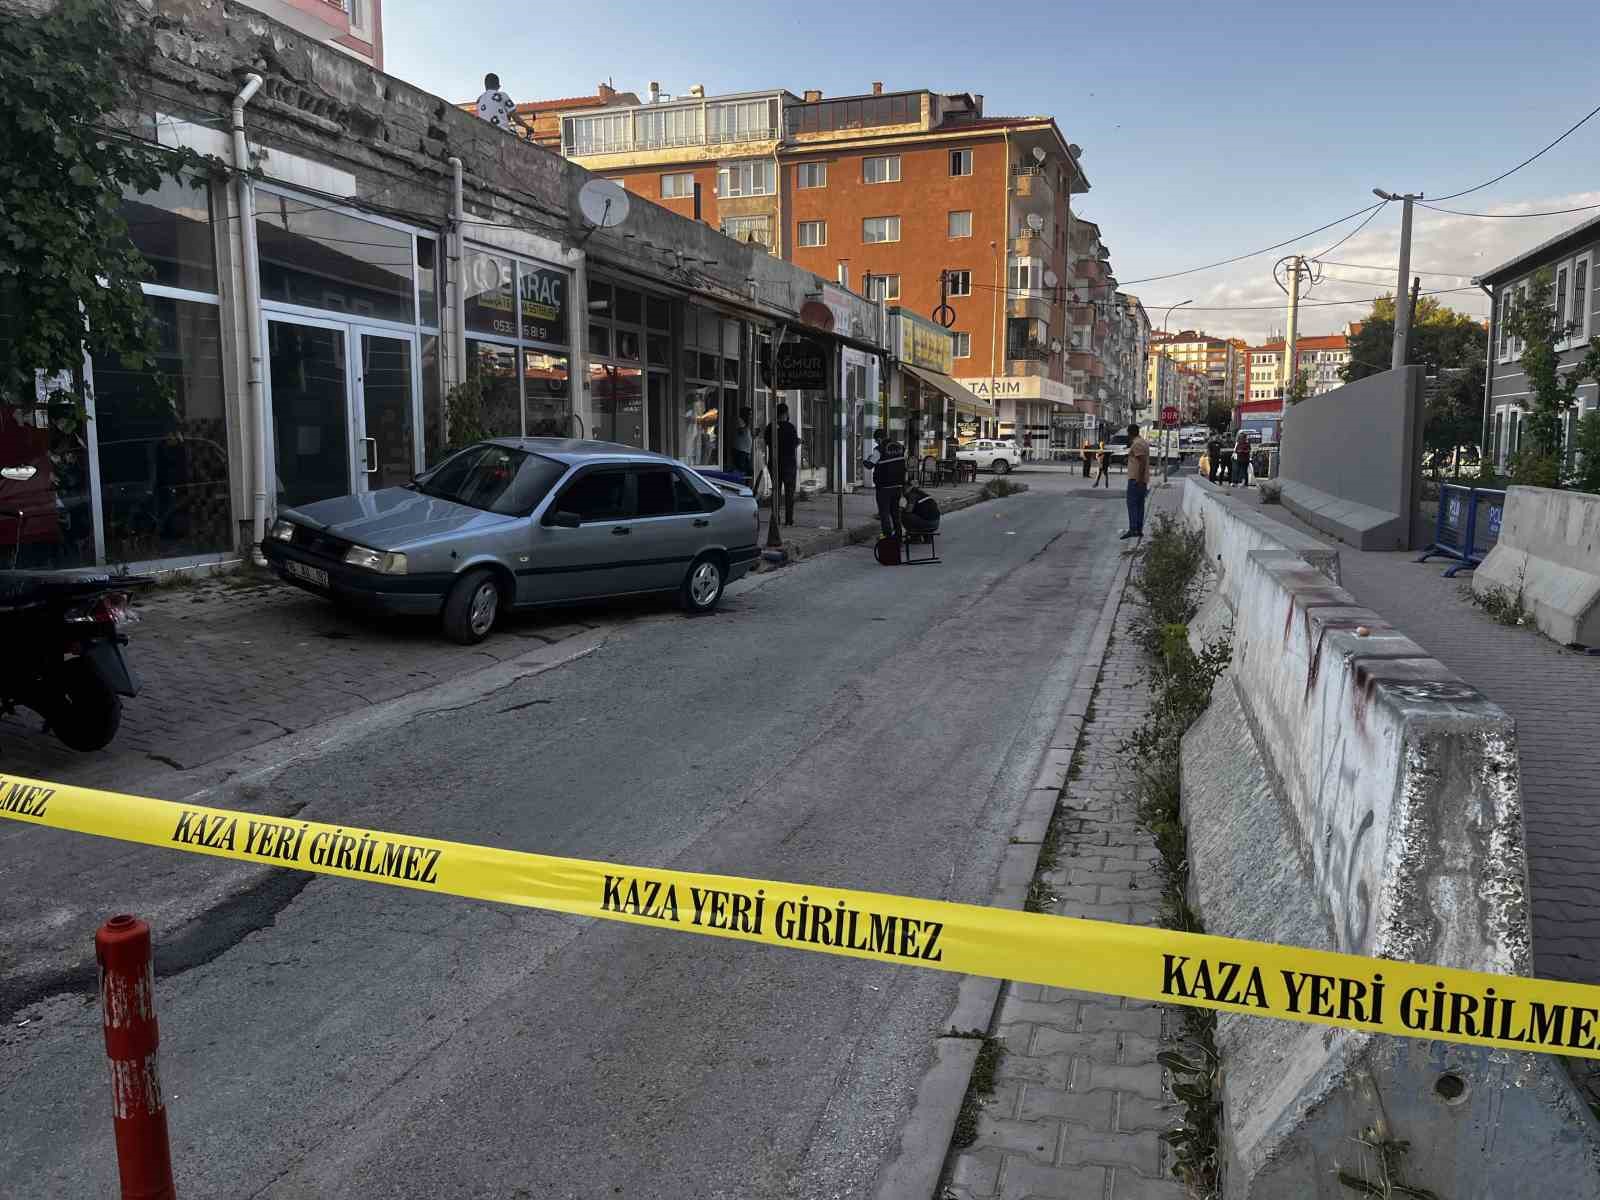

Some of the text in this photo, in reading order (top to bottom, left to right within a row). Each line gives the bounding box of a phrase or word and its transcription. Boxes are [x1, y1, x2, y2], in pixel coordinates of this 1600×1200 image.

[968, 381, 1020, 394] TARIM
[1161, 411, 1178, 421] DUR
[0, 780, 56, 817] LMEZ
[172, 810, 442, 884] KAZA YERİ GİRİLMEZ
[600, 875, 944, 962] KAZA YERİ GİRİLMEZ
[1161, 953, 1600, 1050] KAZA YERİ GİRİLME
